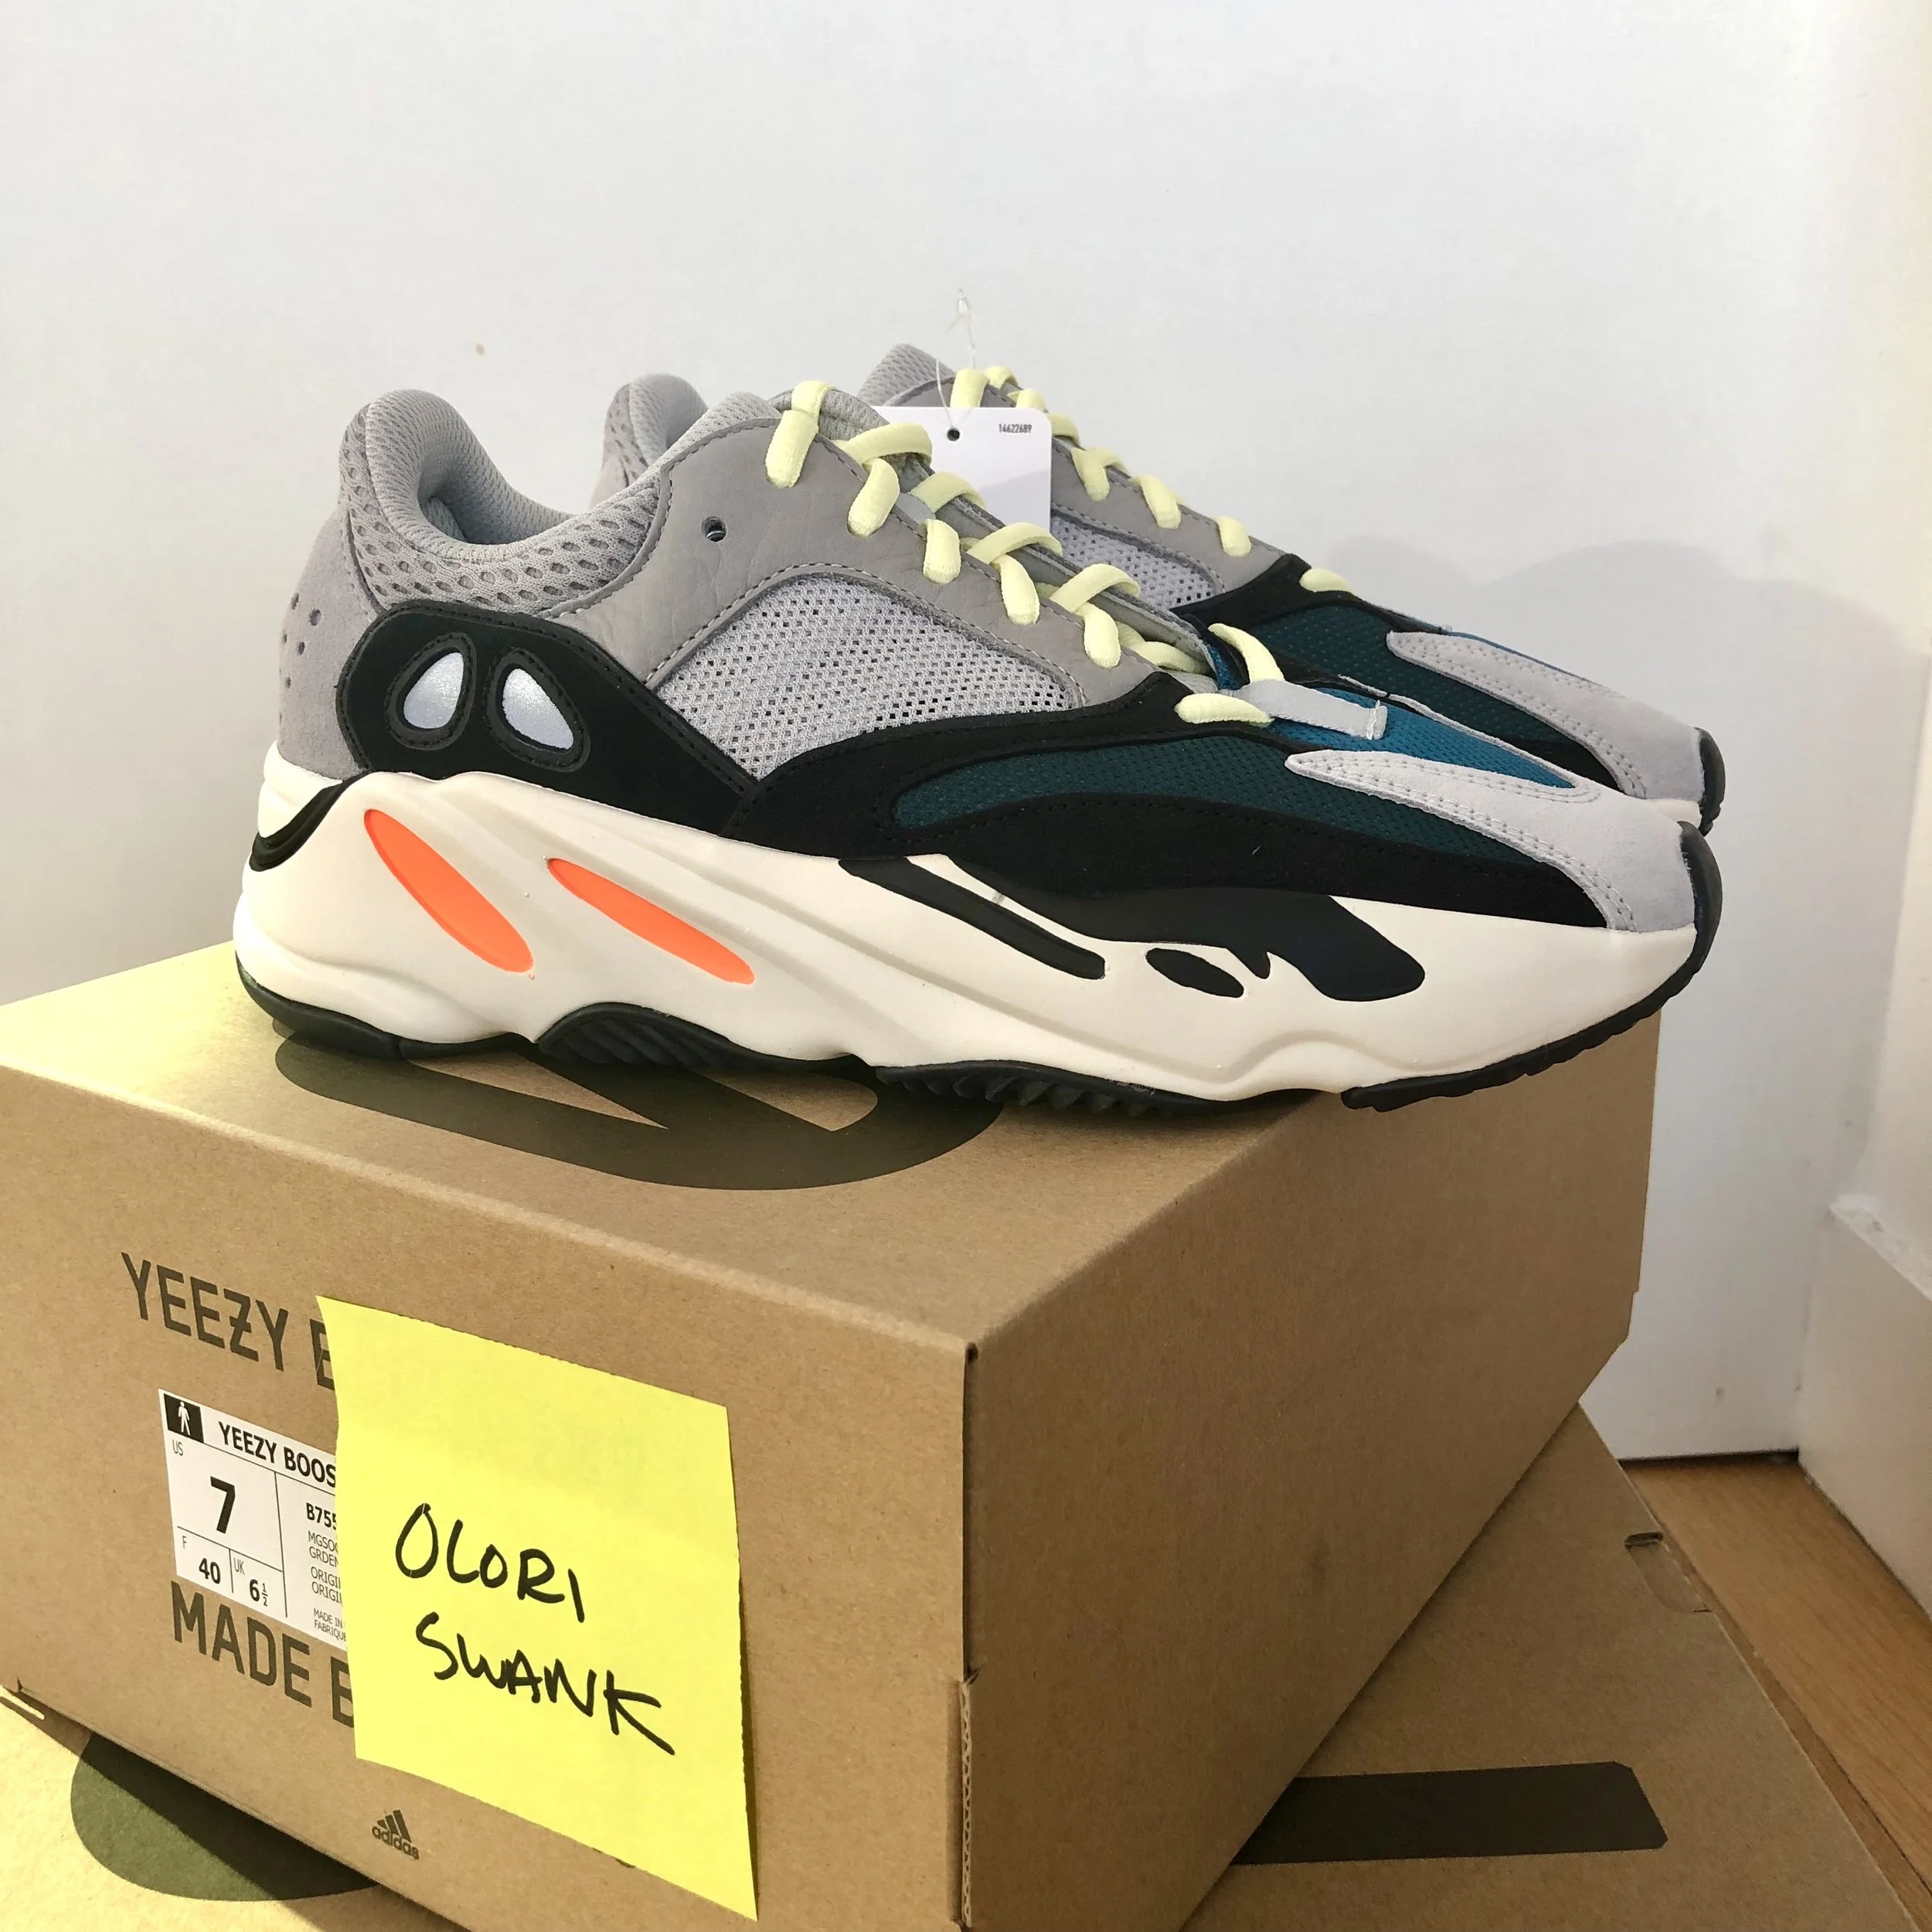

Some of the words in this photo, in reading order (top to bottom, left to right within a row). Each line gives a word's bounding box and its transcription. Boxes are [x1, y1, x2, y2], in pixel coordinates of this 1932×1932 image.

[121, 1251, 289, 1372] YEEZY
[172, 1439, 184, 1456] US
[218, 1420, 277, 1464] YEEZY
[283, 1446, 336, 1488] BOOS
[209, 1475, 236, 1534] 7
[182, 1536, 188, 1549] F
[199, 1558, 221, 1584] 40
[233, 1557, 246, 1575] UK
[311, 1566, 341, 1589] ORIGI
[395, 1502, 585, 1623] OLORI
[313, 1607, 333, 1624] MADE
[335, 1617, 343, 1629] IN
[171, 1580, 312, 1708] MADE
[415, 1611, 675, 1756] SWANK
[371, 1826, 420, 1860] adidas
